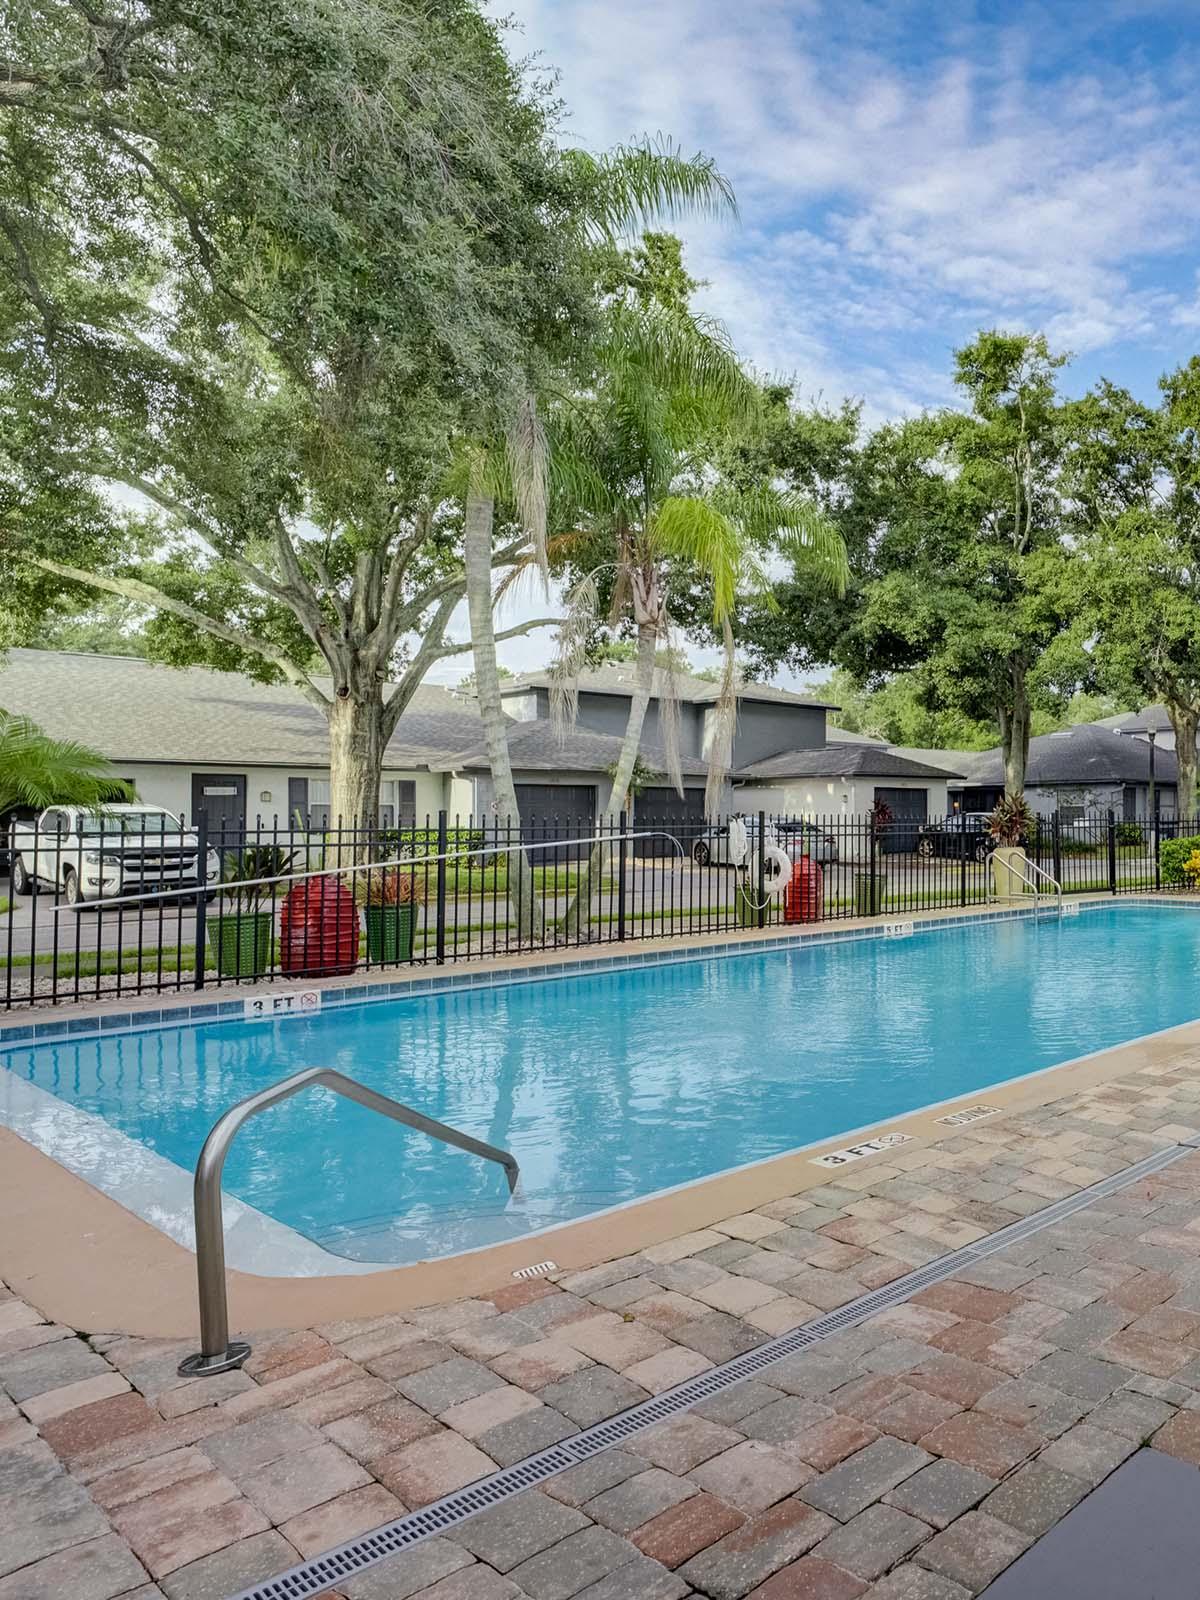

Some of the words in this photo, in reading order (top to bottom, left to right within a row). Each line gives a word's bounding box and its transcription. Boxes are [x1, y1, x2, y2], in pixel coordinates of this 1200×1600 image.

[273, 996, 295, 1010] FT
[951, 1106, 998, 1121] DIVING
[823, 1155, 847, 1164] 3
[846, 1142, 881, 1156] FT
